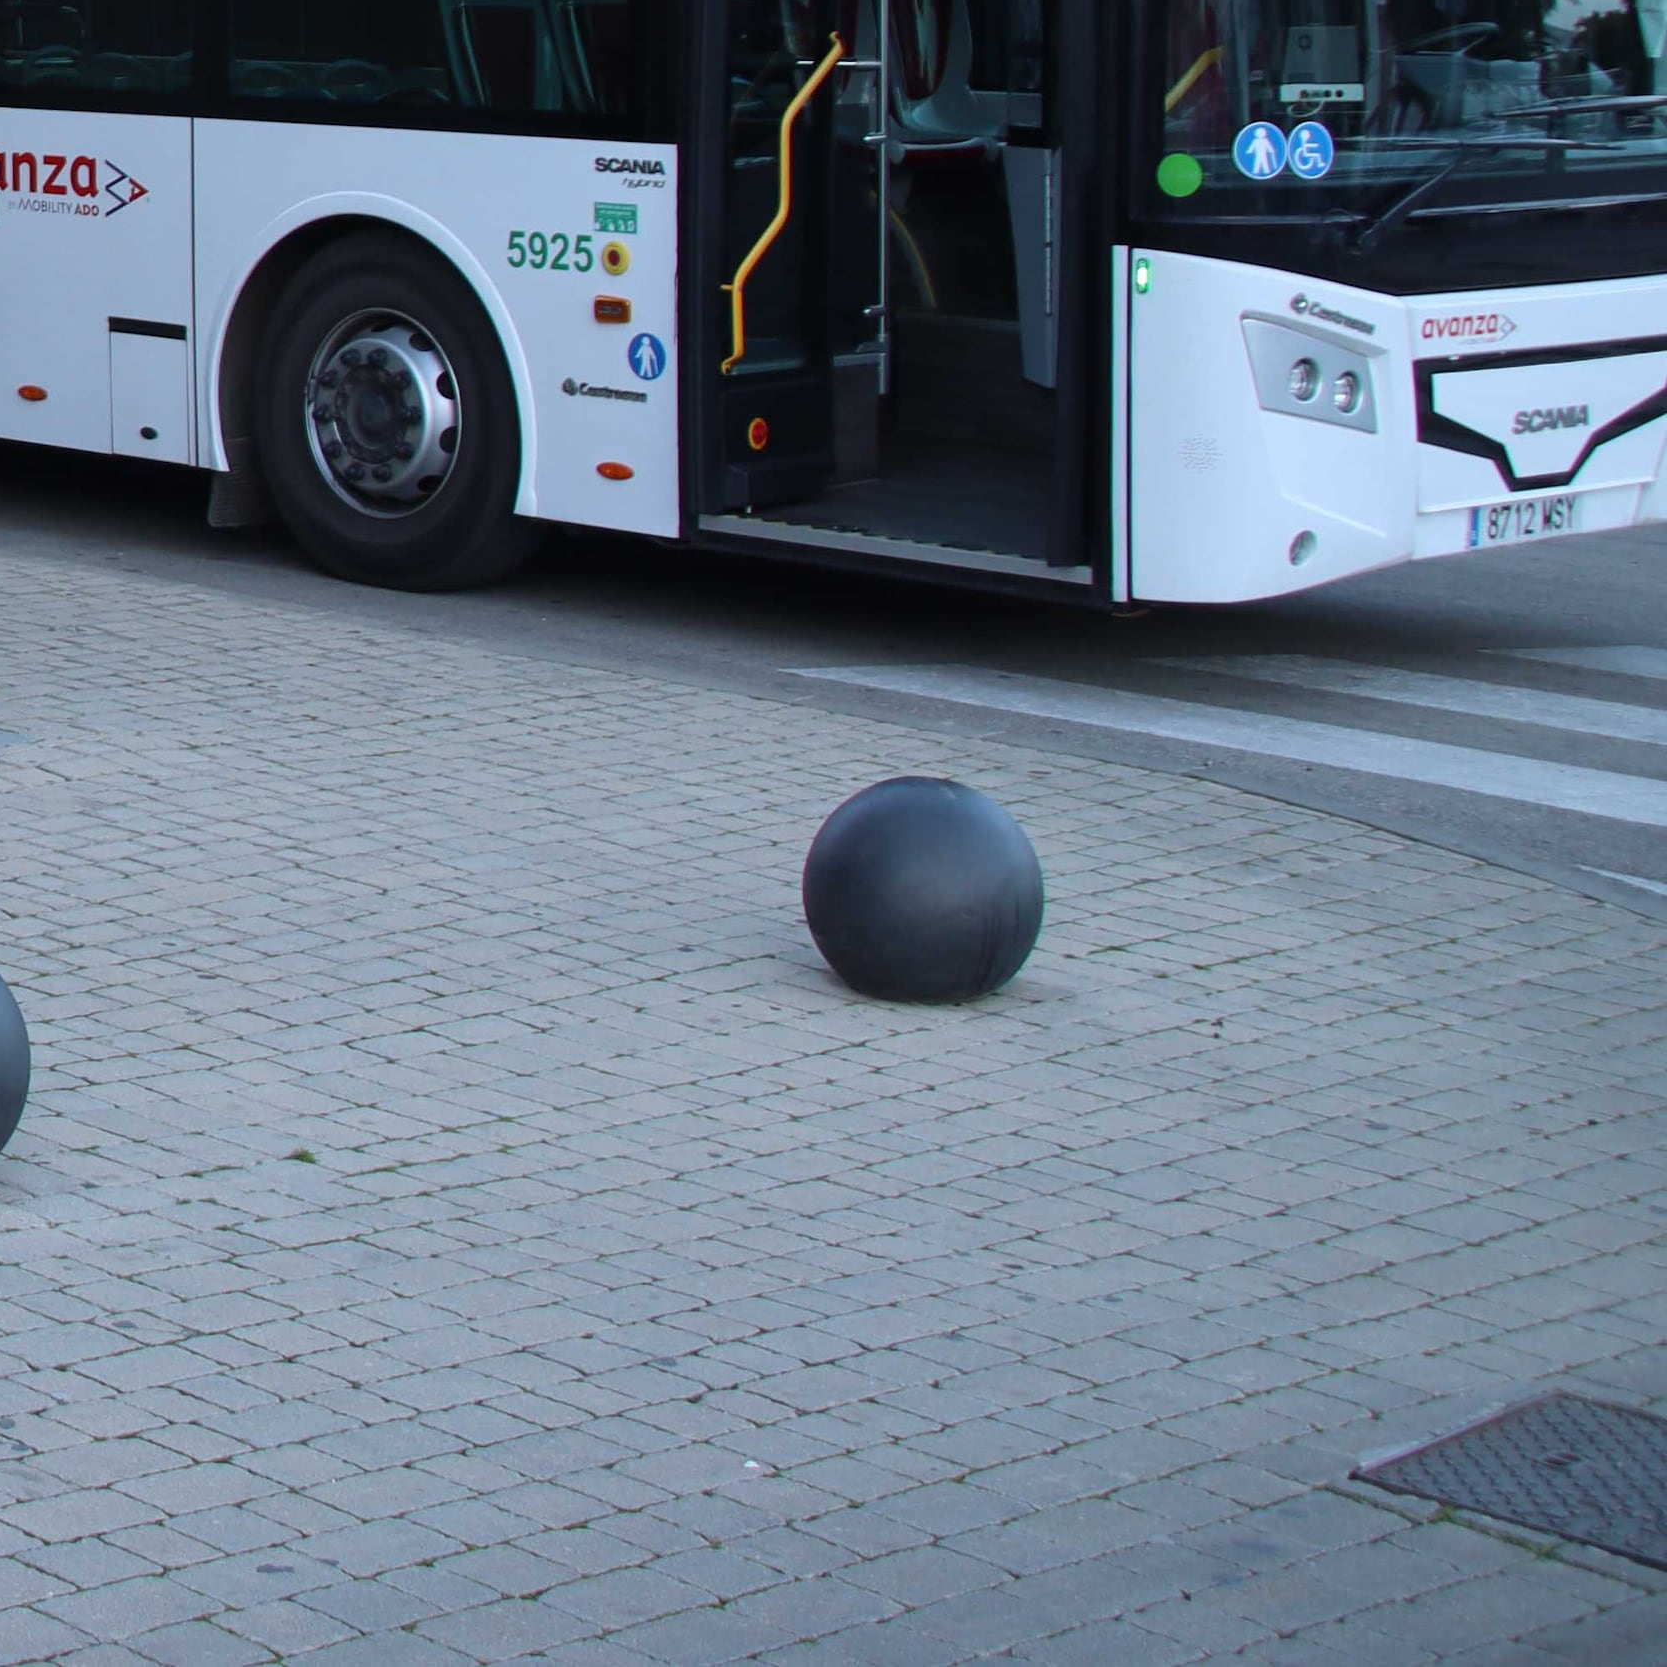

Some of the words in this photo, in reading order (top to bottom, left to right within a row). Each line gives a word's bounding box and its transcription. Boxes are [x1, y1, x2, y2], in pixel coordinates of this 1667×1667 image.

[594, 157, 666, 175] SCANIA
[18, 198, 73, 214] MOBILITY
[74, 203, 100, 216] ADO
[507, 230, 594, 272] 5925
[1421, 313, 1499, 339] avanza
[1512, 404, 1589, 435] SCANIA
[1487, 501, 1536, 540] 8712
